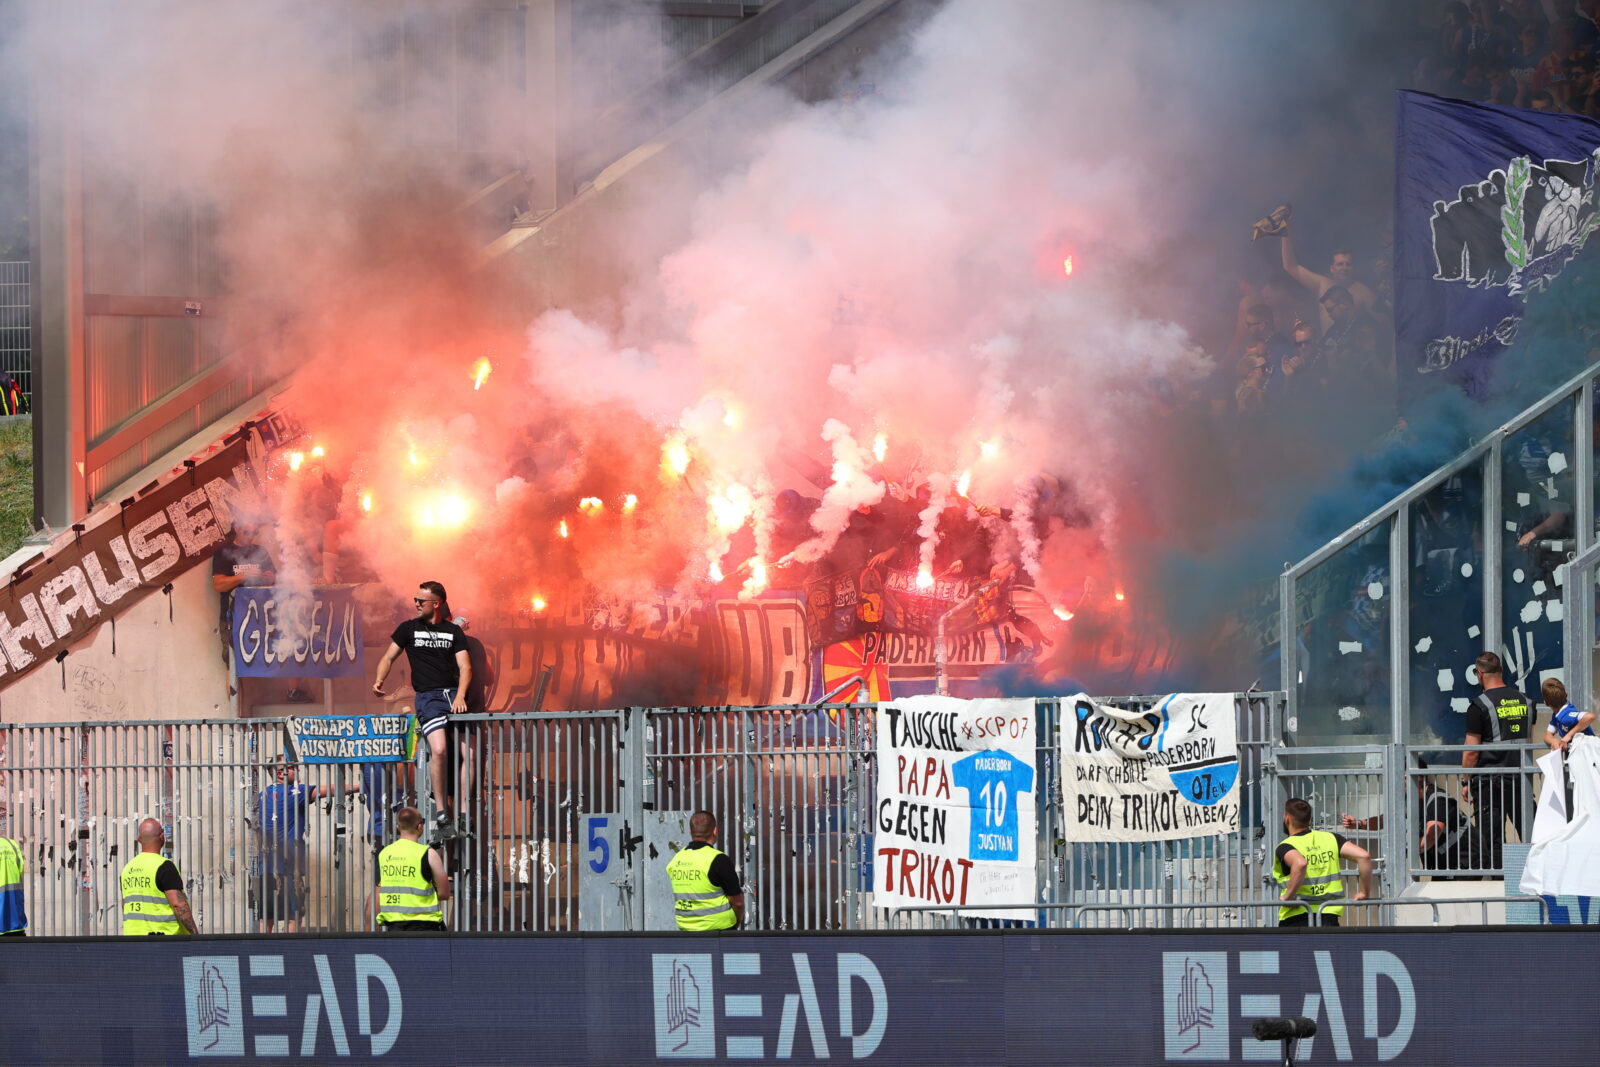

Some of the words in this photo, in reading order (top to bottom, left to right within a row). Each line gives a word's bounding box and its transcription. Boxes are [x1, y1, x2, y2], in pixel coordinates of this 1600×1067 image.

[0, 461, 263, 677] HAUSEN
[294, 717, 354, 736] SCHNAPS
[357, 717, 369, 736] &
[370, 717, 409, 735] WEED
[1075, 700, 1117, 753] RON
[1187, 703, 1208, 734] SC
[1496, 705, 1528, 719] SECURITY
[885, 708, 963, 752] TAUSCHE
[299, 738, 407, 758] AUSWÄRTSSIEG!
[1146, 737, 1216, 768] PADERBORN
[898, 754, 951, 800] PAPA
[975, 758, 1012, 772] PADERBORN
[1077, 766, 1102, 782] DARF
[1106, 767, 1121, 784] ICH
[1122, 757, 1148, 784] BITTE
[980, 780, 1007, 827] 10
[1078, 793, 1113, 830] DEIN
[1120, 790, 1179, 833] TRIKOT
[879, 798, 946, 845] GEGEN
[588, 817, 609, 874] 5
[978, 833, 1013, 852] JUSTVAN
[380, 865, 416, 877] RDNER
[670, 869, 702, 881] RDNER
[878, 848, 974, 905] TRIKOT
[1310, 884, 1325, 895] 129
[130, 902, 142, 912] 13
